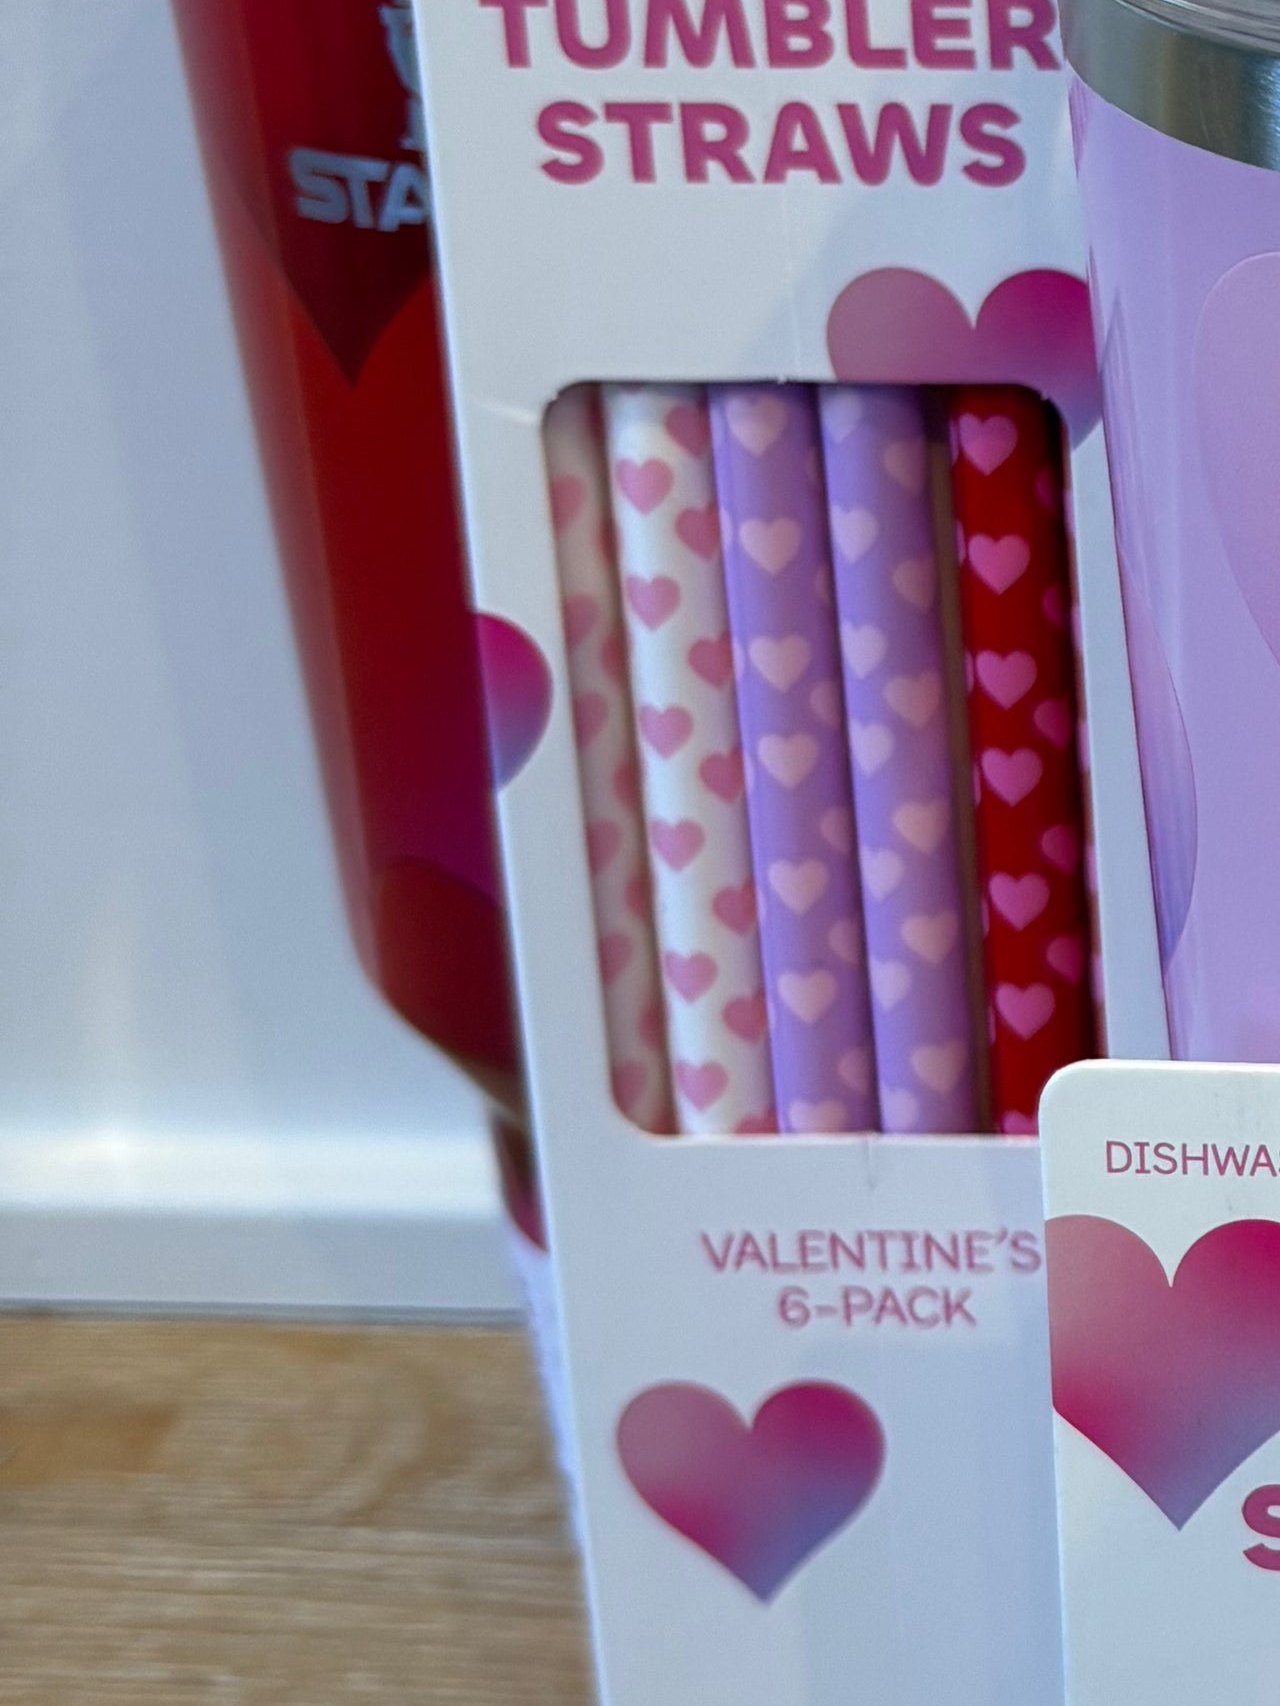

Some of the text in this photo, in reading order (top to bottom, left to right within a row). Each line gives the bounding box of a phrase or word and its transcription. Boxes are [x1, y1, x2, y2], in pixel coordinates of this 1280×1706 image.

[535, 99, 1027, 187] STRAWS
[700, 1227, 1043, 1275] VALENTINE'S
[777, 1284, 977, 1328] 6-PACK
